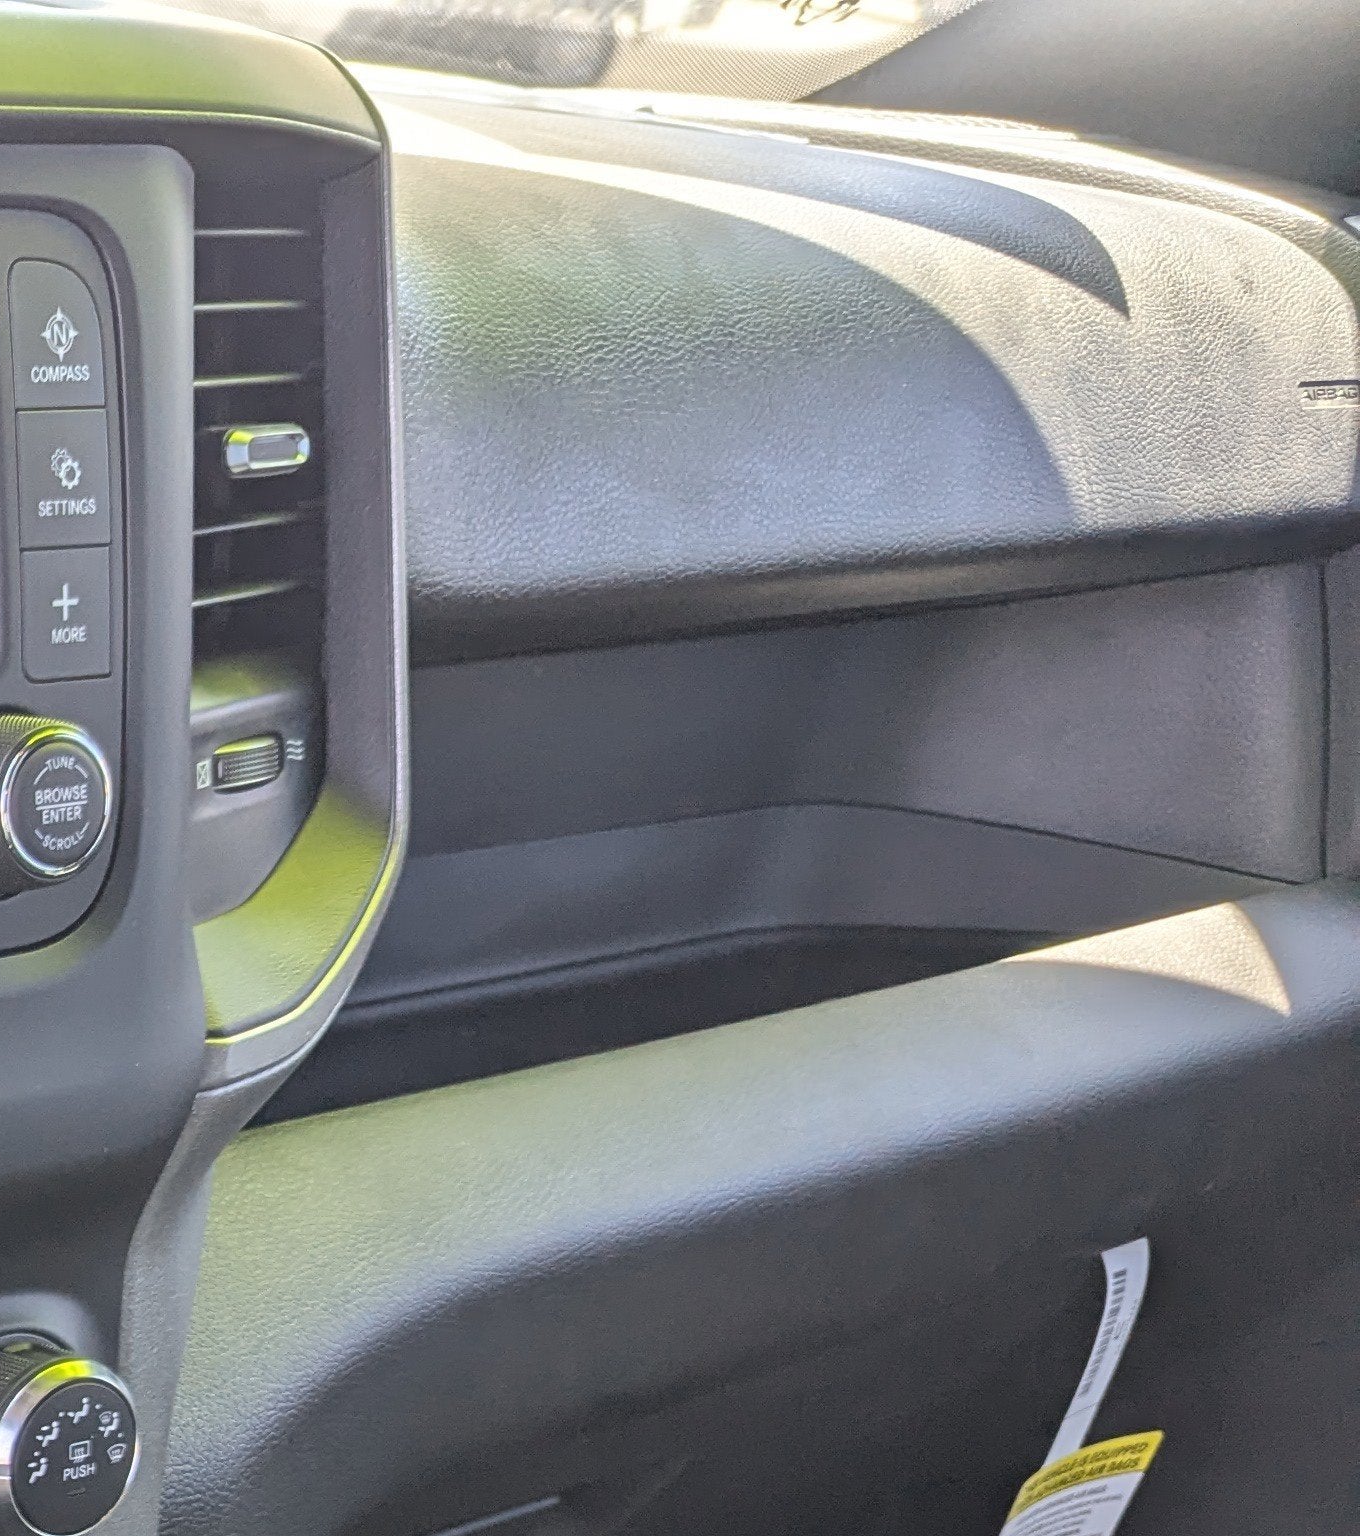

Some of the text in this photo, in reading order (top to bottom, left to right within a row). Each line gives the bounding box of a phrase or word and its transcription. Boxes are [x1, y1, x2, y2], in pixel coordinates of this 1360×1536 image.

[30, 364, 91, 383] COMPASS
[1301, 386, 1358, 401] AIRBAG
[38, 499, 98, 517] SETTINGS
[51, 626, 87, 644] MORE
[45, 755, 76, 771] TUNE
[34, 784, 88, 806] BROWSE
[42, 806, 82, 825] ENTER
[41, 832, 84, 851] SCROLL
[63, 1462, 96, 1482] PUSH
